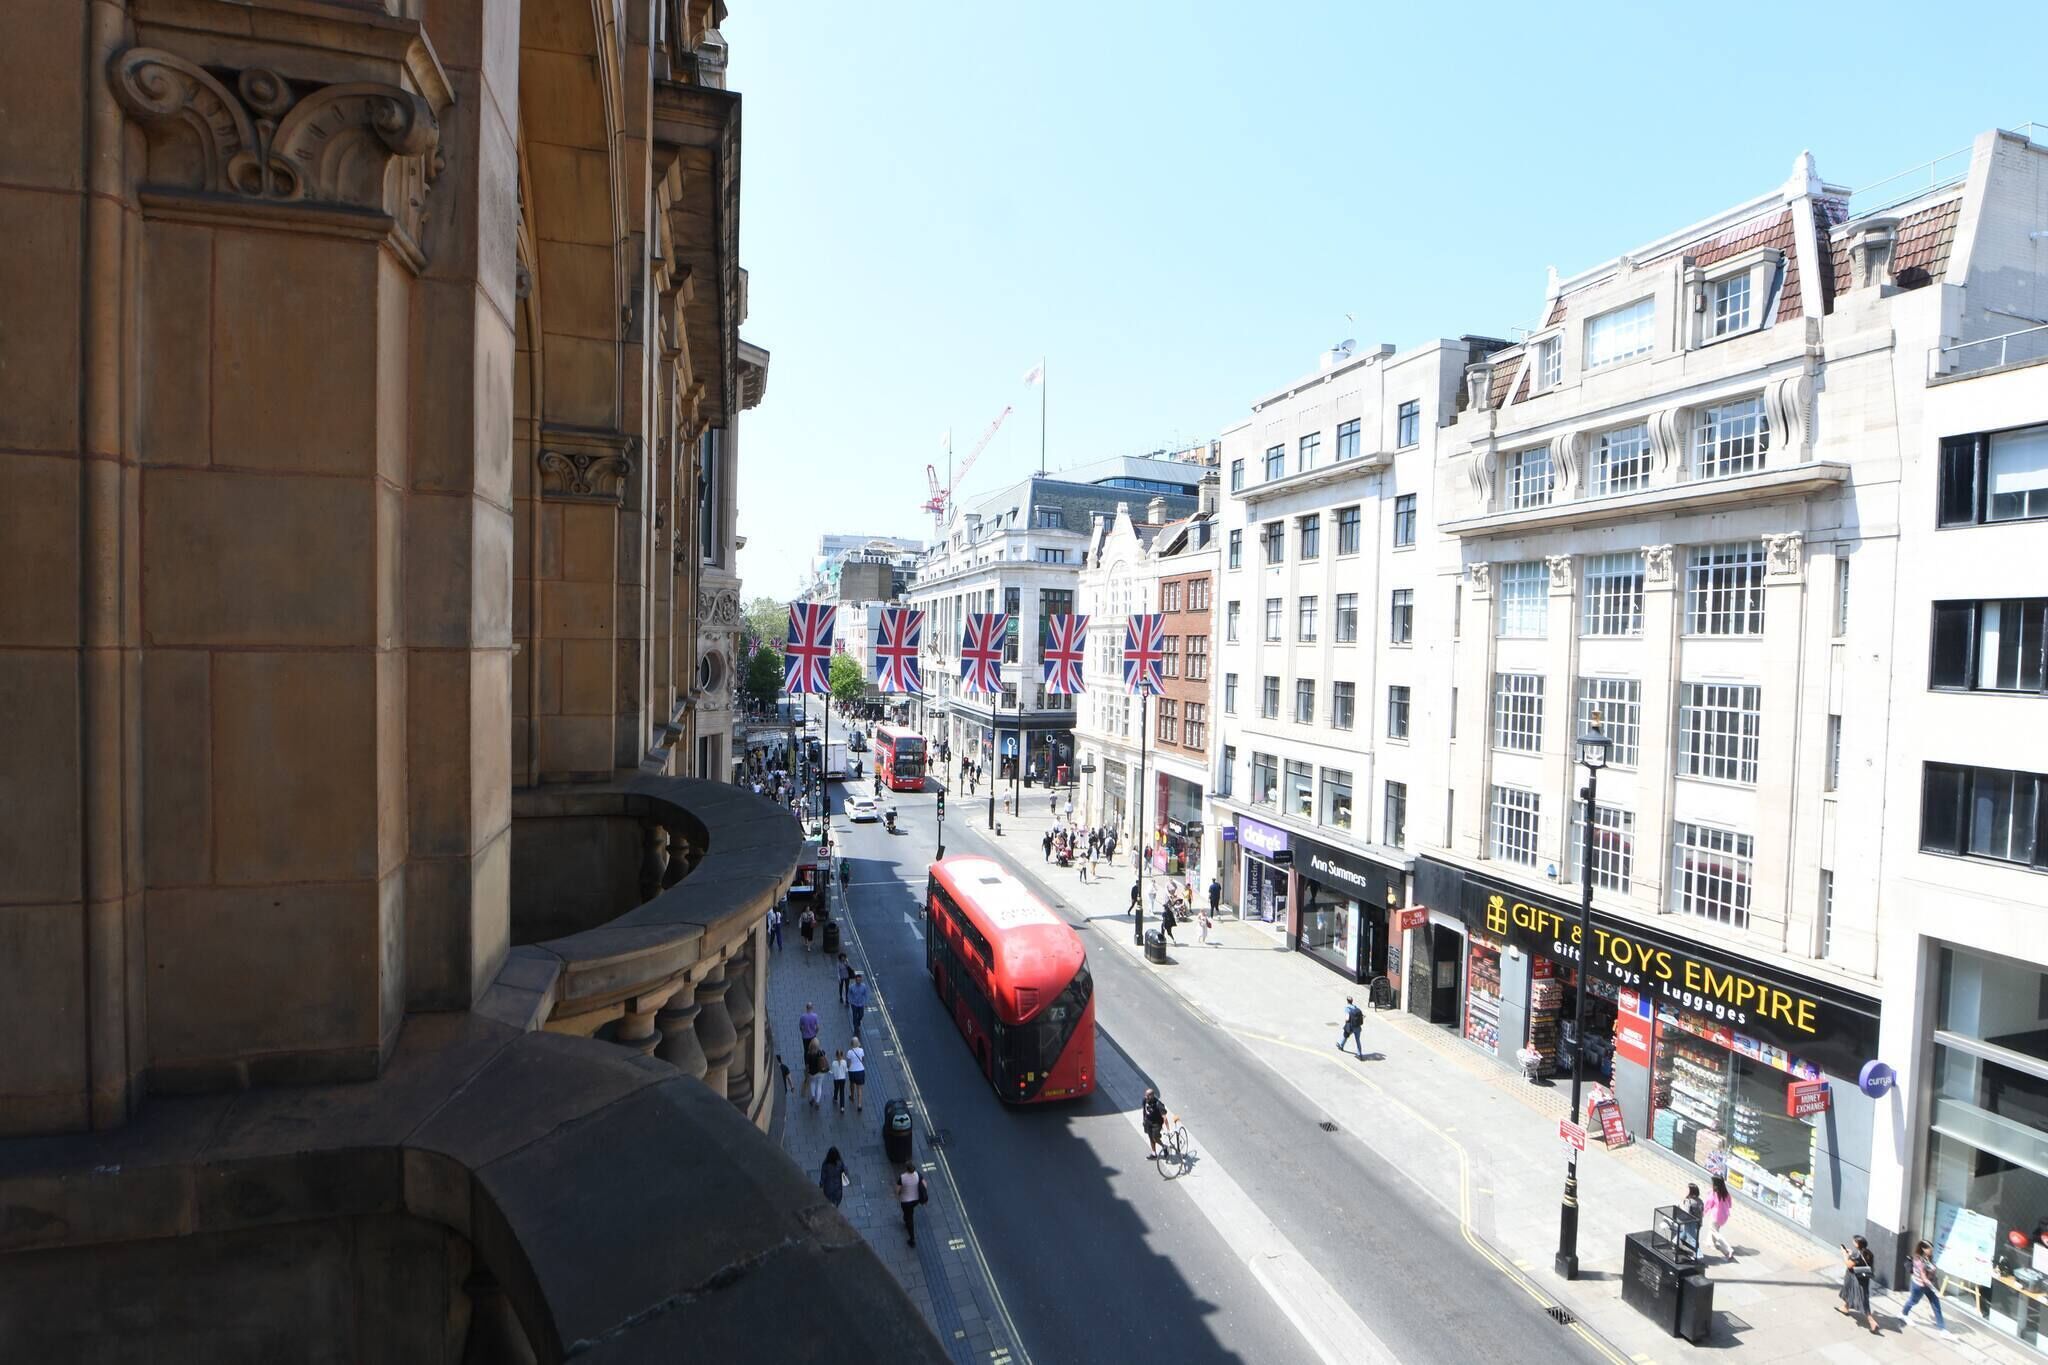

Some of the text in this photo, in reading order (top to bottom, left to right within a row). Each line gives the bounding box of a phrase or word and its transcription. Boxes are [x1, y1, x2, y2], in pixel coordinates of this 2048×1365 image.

[1311, 854, 1367, 888] Ann Summers
[1512, 903, 1817, 1034] GIFT & TOYS EMPIRE
[1553, 941, 1580, 962] Gift
[1606, 960, 1641, 985] Toys
[1662, 981, 1746, 1025] Luggages
[1050, 1007, 1065, 1021] 73
[1868, 1076, 1892, 1087] currys
[1801, 1093, 1821, 1104] MONEY
[1796, 1101, 1825, 1114] EXCHANGE
